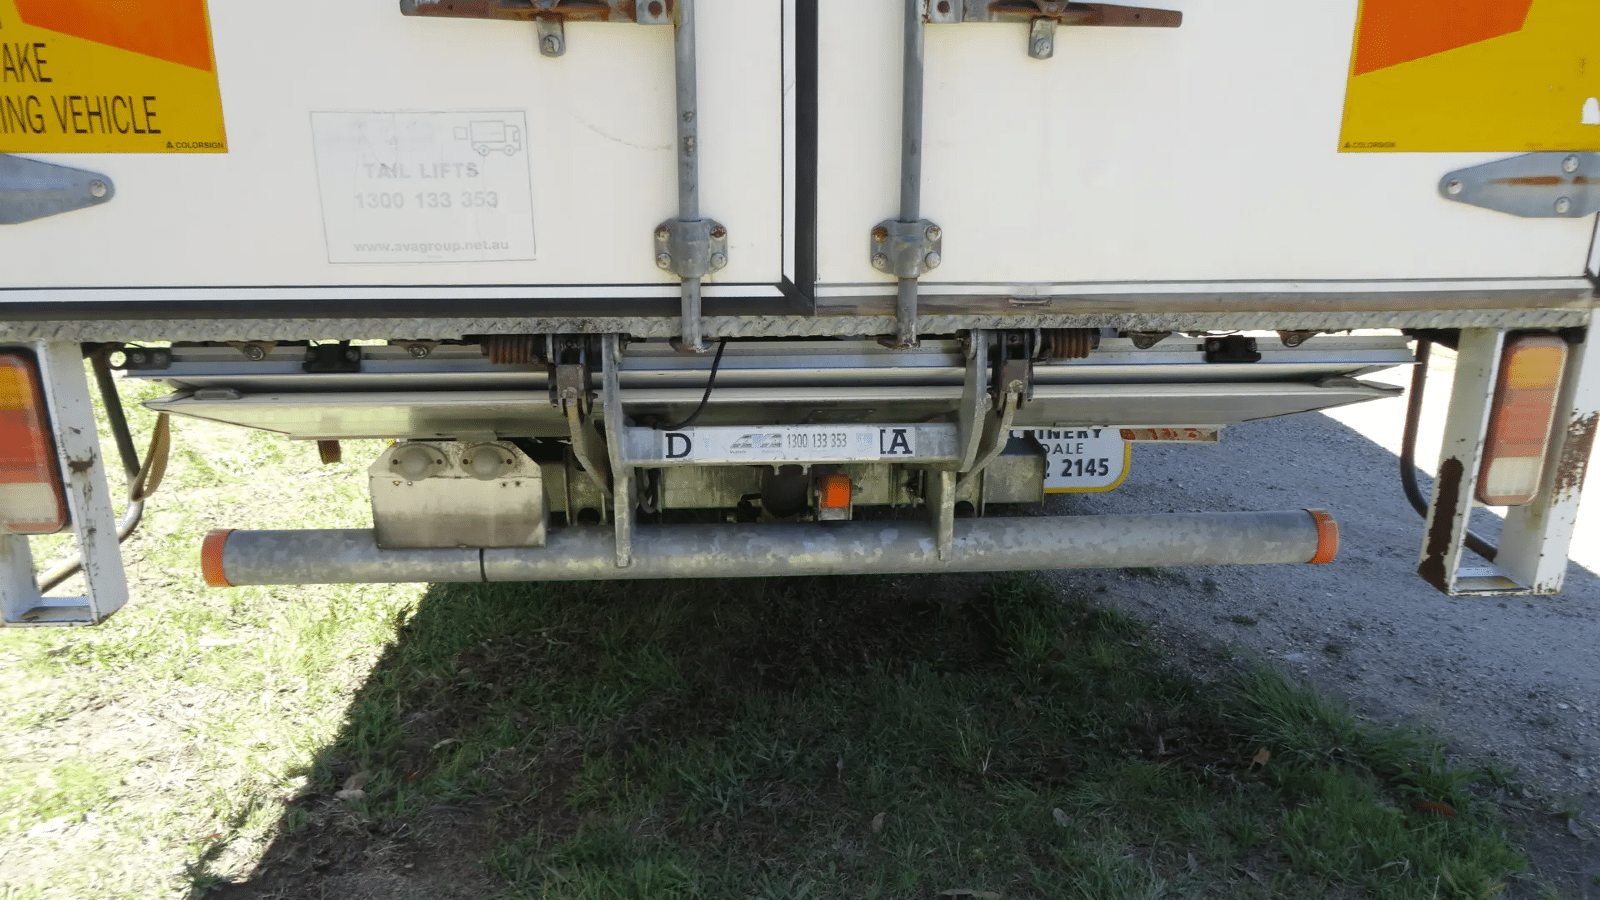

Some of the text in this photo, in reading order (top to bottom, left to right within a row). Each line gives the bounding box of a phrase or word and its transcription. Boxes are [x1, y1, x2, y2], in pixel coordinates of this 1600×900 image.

[3, 43, 52, 83] AKE
[51, 95, 161, 134] VEHICLE
[175, 141, 224, 149] COLORSIGN
[364, 162, 479, 179] TAIL LIFTS
[355, 191, 499, 209] 1300 133 353
[353, 239, 510, 254] www.avagroup.net.au
[665, 432, 692, 459] D
[786, 433, 847, 448] 1300 133 353
[1061, 458, 1109, 477] 2145
